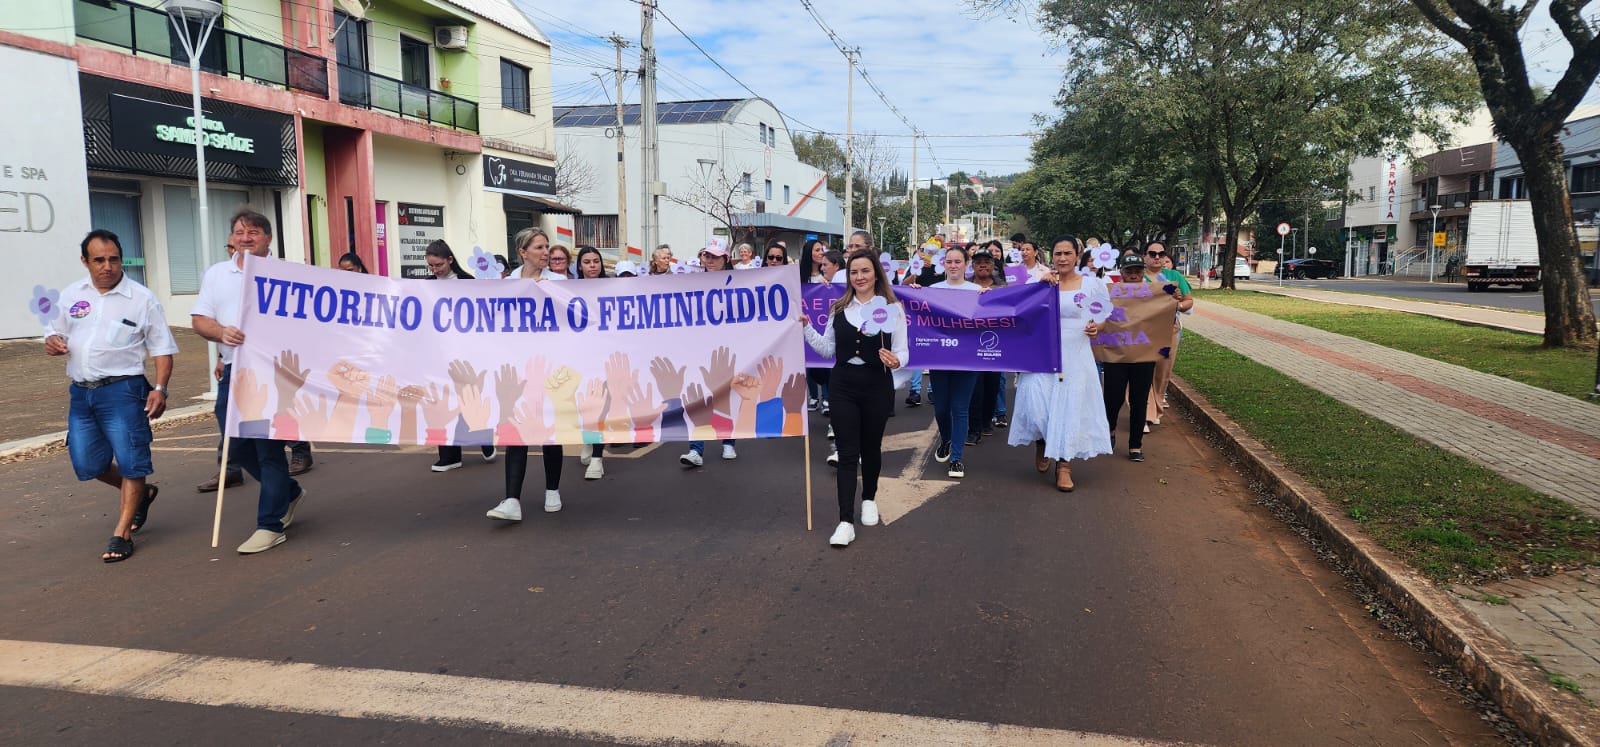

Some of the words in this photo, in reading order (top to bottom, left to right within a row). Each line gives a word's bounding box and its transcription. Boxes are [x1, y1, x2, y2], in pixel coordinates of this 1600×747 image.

[187, 115, 226, 132] CÍNICA
[209, 132, 255, 153] SAÚDE
[4, 165, 13, 178] E
[21, 166, 49, 181] SPA
[254, 276, 423, 331] VITORINO
[432, 297, 560, 333] CONTRA
[566, 296, 589, 333] O
[597, 274, 790, 331] FEMINICÍDIO
[910, 299, 931, 313] DA
[917, 314, 1016, 329] MULHERES!
[940, 338, 959, 347] 190
